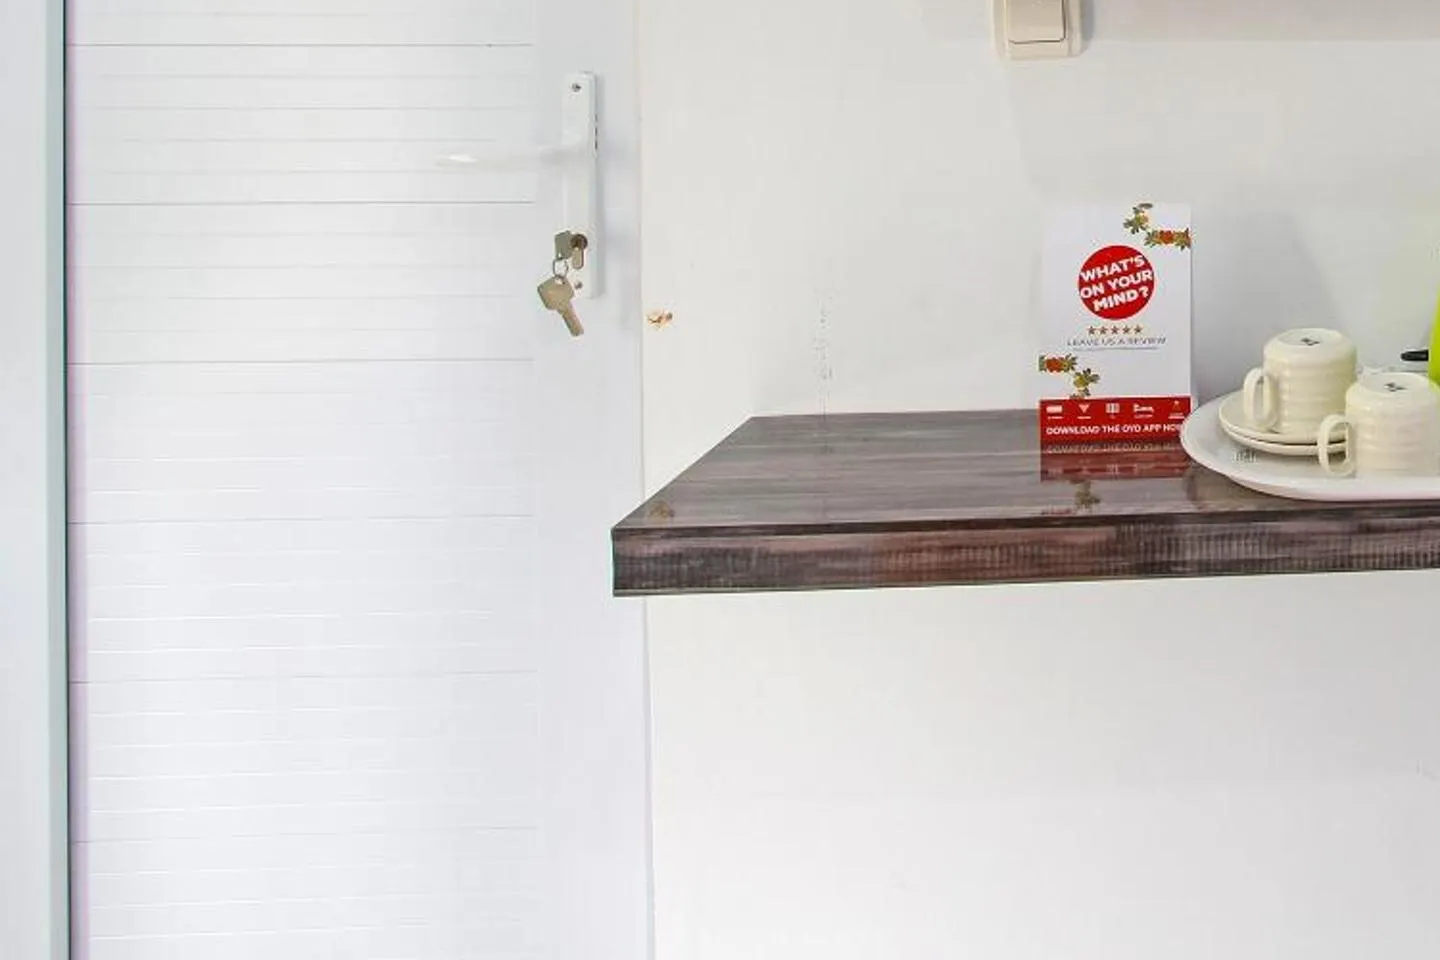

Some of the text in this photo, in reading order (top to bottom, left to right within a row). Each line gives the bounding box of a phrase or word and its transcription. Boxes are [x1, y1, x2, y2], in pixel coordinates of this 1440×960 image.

[1080, 255, 1145, 282] WHAT'S
[1080, 269, 1153, 299] ON YOUR
[1093, 286, 1149, 312] MIND?
[1045, 425, 1100, 435] DOWNLOAD
[1102, 424, 1120, 433] THE
[1121, 424, 1141, 433] OYO
[1142, 423, 1162, 431] APP
